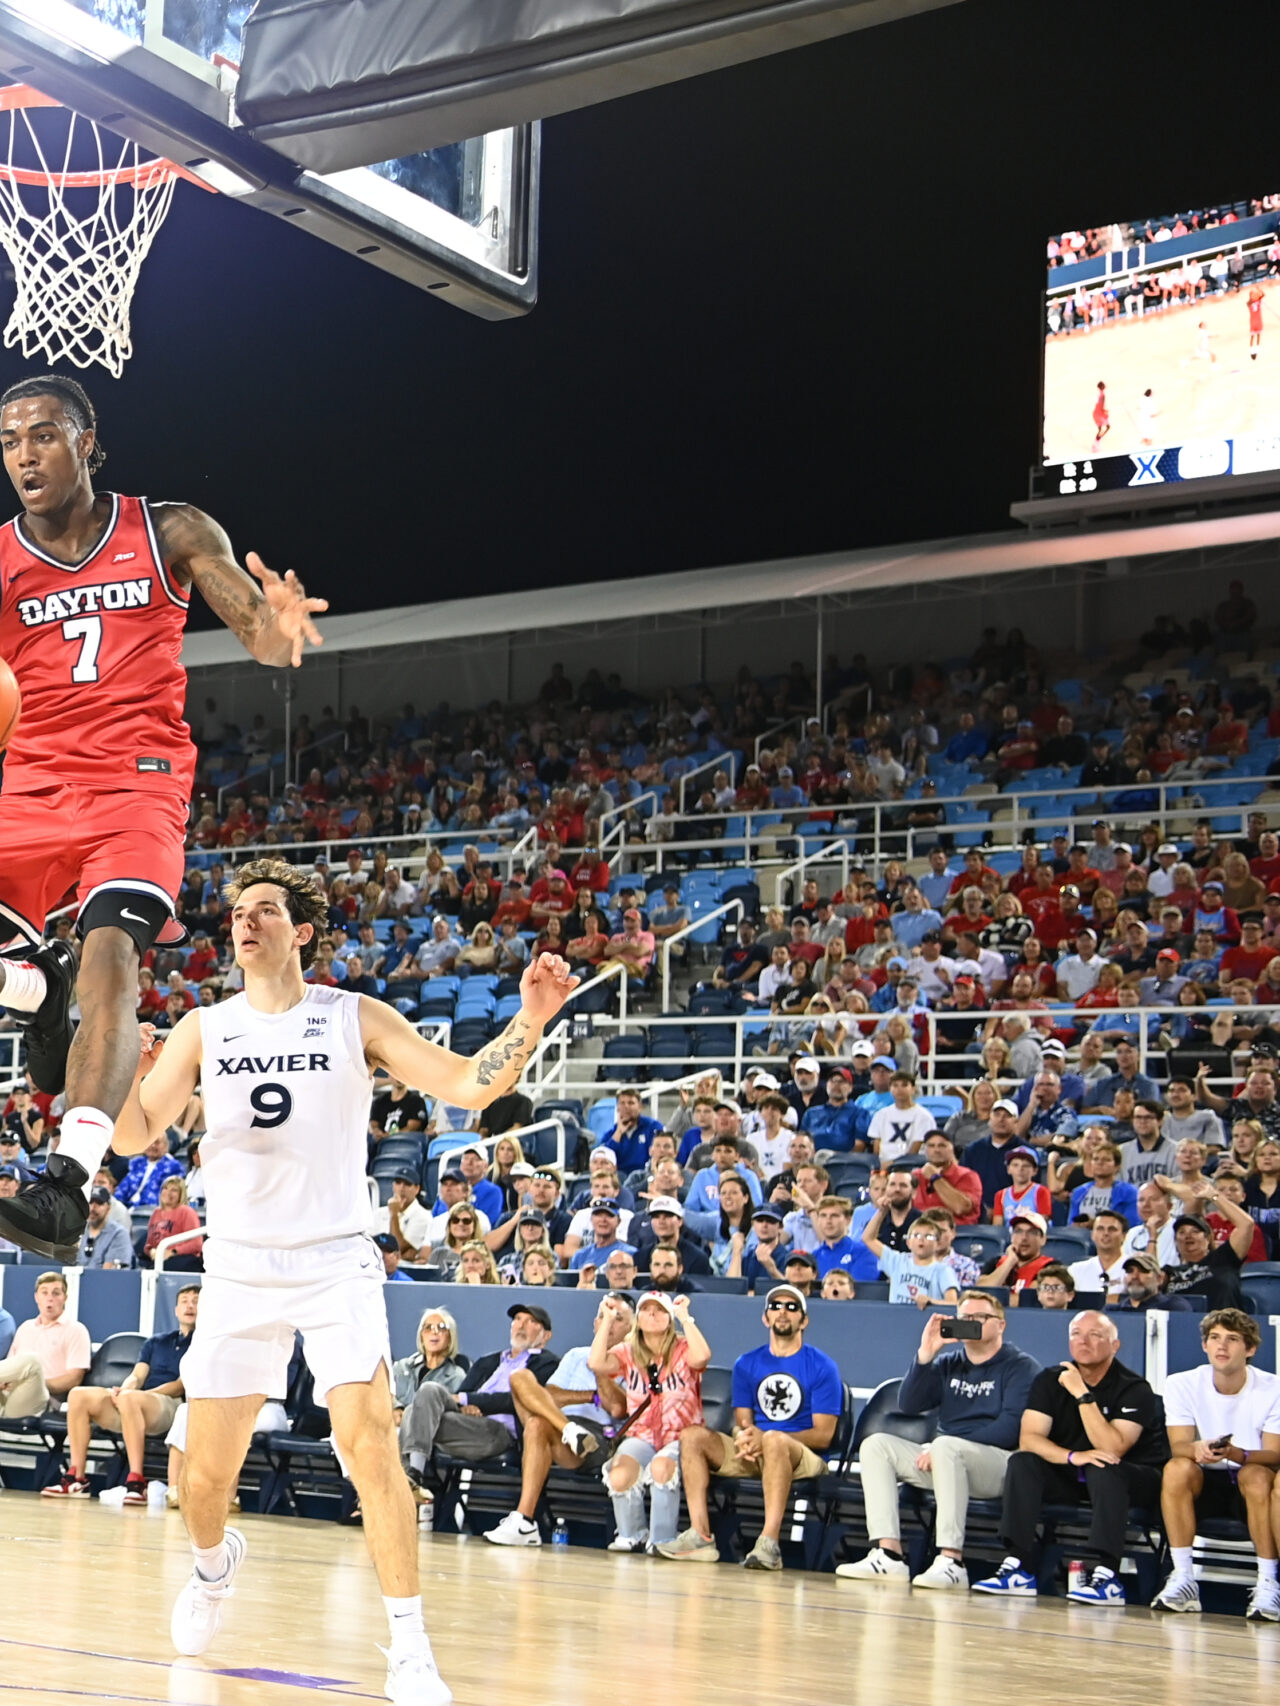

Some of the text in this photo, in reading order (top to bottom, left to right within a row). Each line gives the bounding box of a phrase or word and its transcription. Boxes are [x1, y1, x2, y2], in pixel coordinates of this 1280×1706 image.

[17, 578, 152, 627] DAYTON
[62, 614, 102, 683] 7
[305, 1016, 327, 1025] 1N5
[215, 1052, 332, 1077] XAVIER
[249, 1082, 294, 1129] 9
[889, 1121, 912, 1143] X
